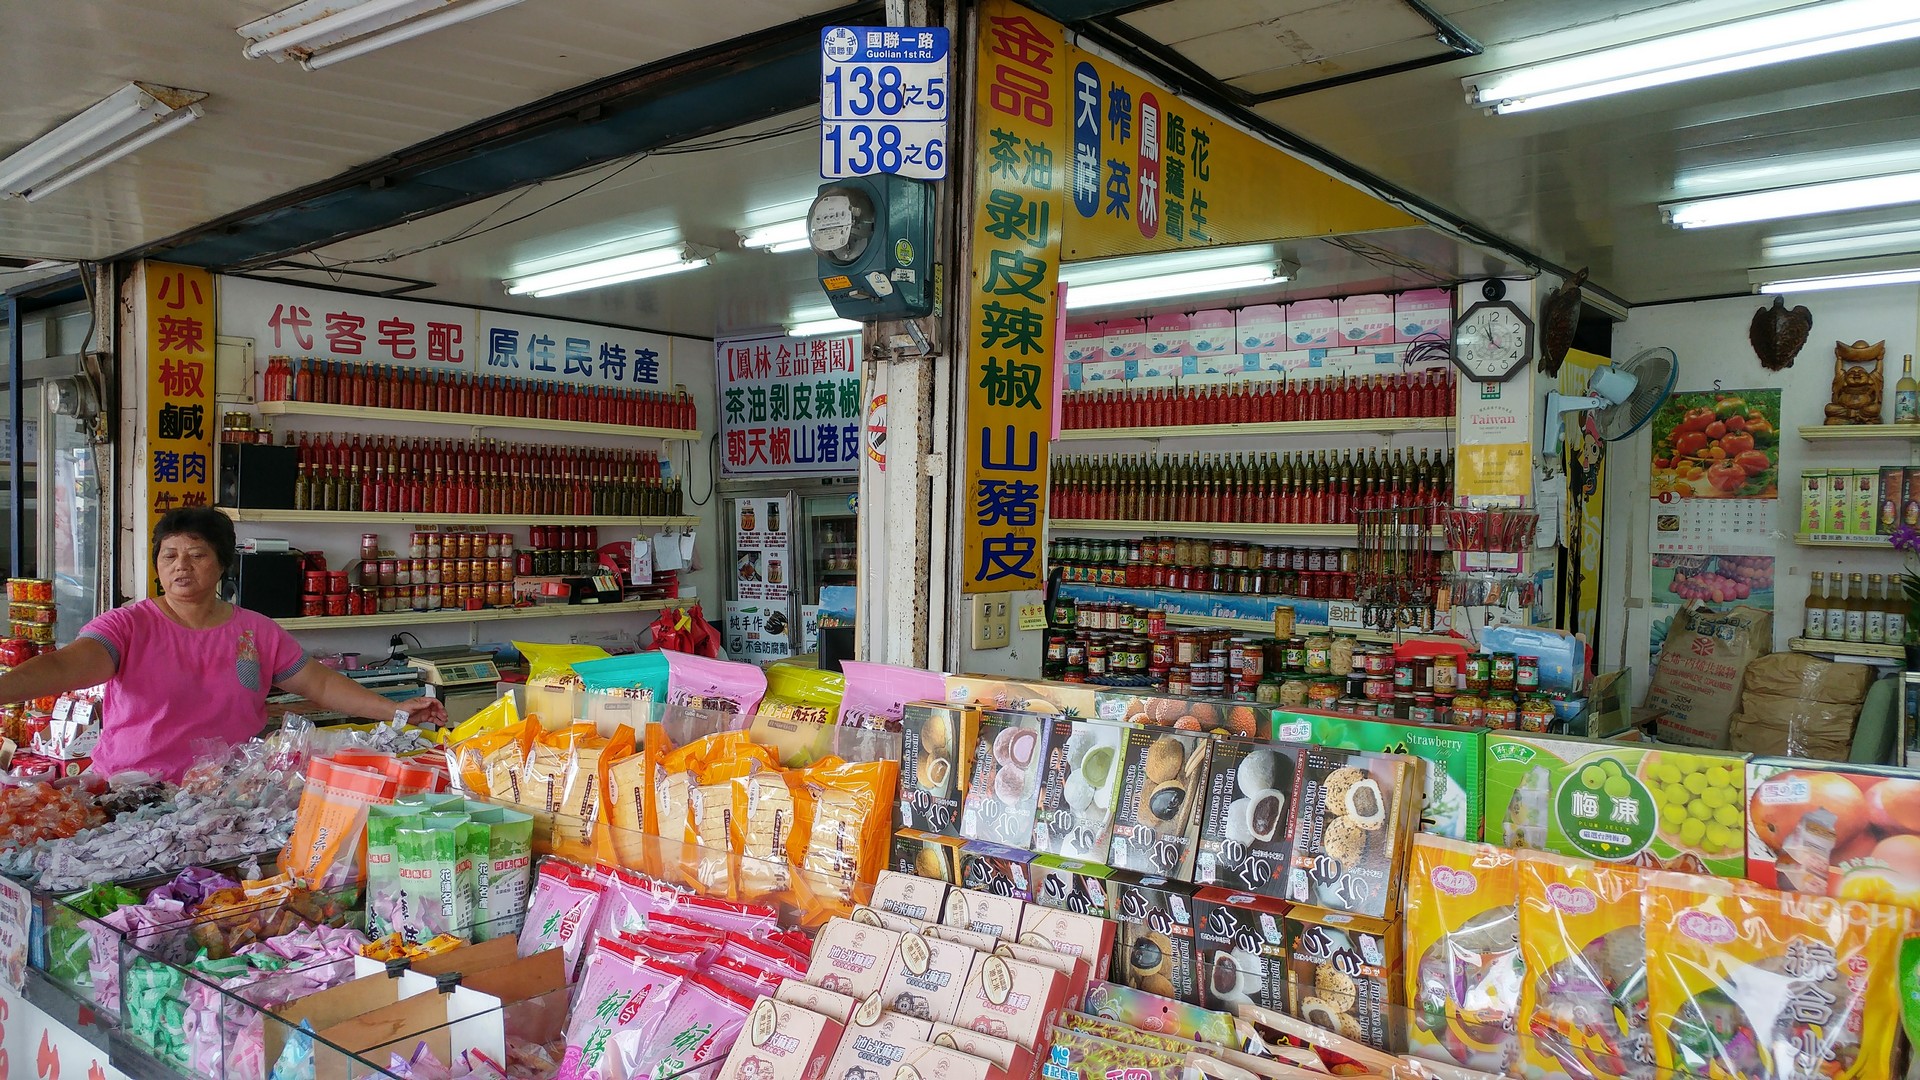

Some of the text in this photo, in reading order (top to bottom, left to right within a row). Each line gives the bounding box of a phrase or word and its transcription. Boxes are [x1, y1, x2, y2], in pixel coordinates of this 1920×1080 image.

[825, 28, 857, 46] 花蓮市
[828, 47, 854, 56] 國聯里
[866, 50, 934, 59] Guolian 1st Rd.
[867, 32, 934, 49] 國聯一路
[990, 15, 1055, 127] 金品
[825, 65, 944, 118] 138之5
[825, 124, 943, 175] 138之6
[1077, 74, 1099, 206] 天祥
[1107, 81, 1131, 221] 榨菜
[989, 127, 1053, 192] 茶油
[1140, 103, 1160, 227] 鳳林
[1165, 111, 1186, 242] 脆蘿蔔
[1190, 126, 1211, 243] 花生
[268, 304, 465, 364] 代客宅配
[1489, 311, 1500, 322] 12
[1512, 323, 1520, 334] 2
[488, 328, 661, 385] 原住民特產
[1466, 350, 1474, 361] 8
[1509, 350, 1518, 360] 4
[1514, 337, 1523, 347] 3
[1487, 362, 1496, 373] 6
[1501, 360, 1509, 370] 5
[725, 378, 861, 425] 茶油剝皮辣椒
[1470, 414, 1516, 425] Taiwan
[154, 451, 205, 483] 豬肉
[975, 425, 1038, 583] 山豬皮
[729, 615, 763, 632] 純手作
[1329, 605, 1358, 623] 魚肚
[745, 641, 789, 656] 不含防腐劑
[1281, 725, 1310, 738] 雪の恋
[1406, 732, 1463, 752] Strawberry
[1227, 768, 1236, 792] Mochi
[1764, 783, 1807, 797] 雪の恋
[1120, 787, 1132, 822] Japanese
[1207, 773, 1224, 837] Japanese Style
[1299, 780, 1318, 853] Japanese Style
[1310, 785, 1328, 854] Sesame Mochi
[1578, 820, 1631, 832] PLUM JELLY
[439, 869, 454, 917] 花蓮名產
[478, 862, 489, 910] 花蓮名產
[1780, 892, 1913, 931] MOCHI
[1358, 978, 1368, 1014] Sesame
[1370, 981, 1381, 1022] Japanese
